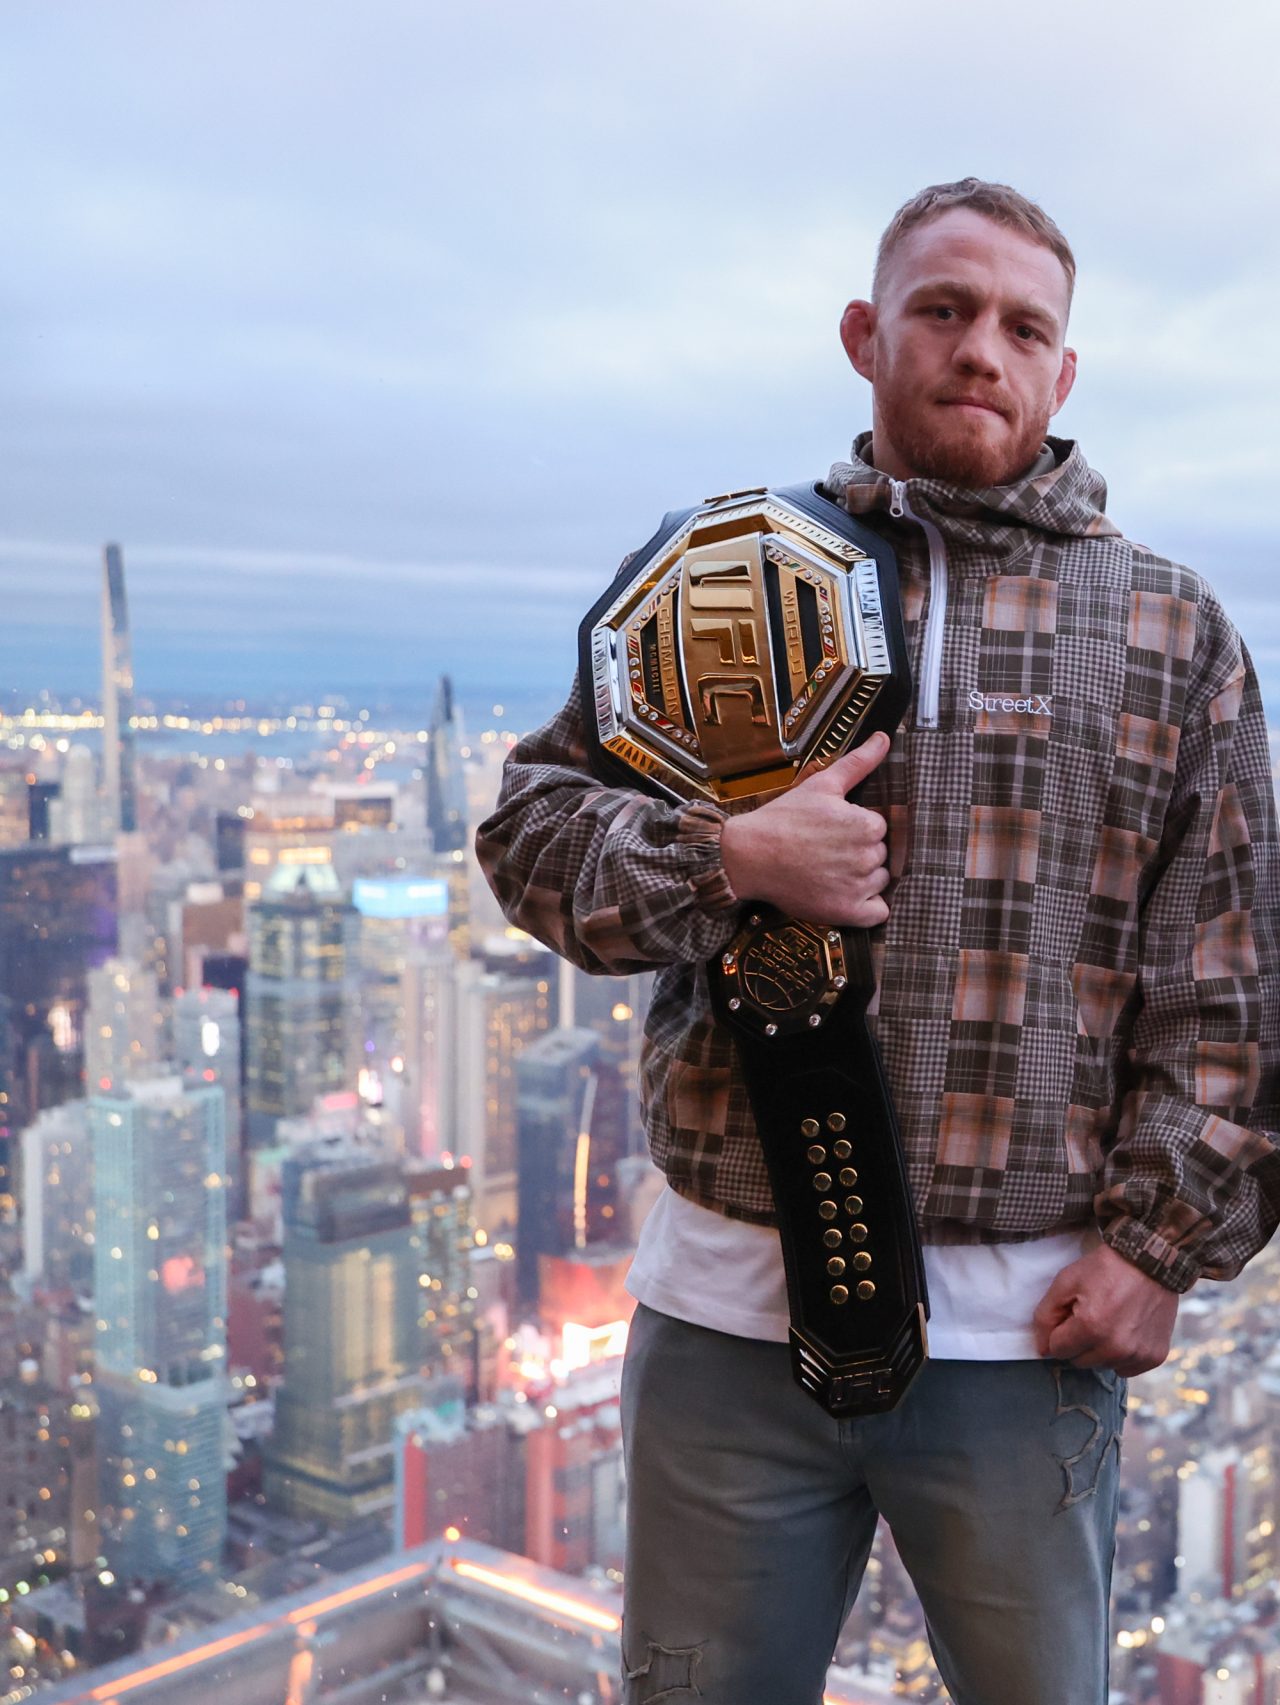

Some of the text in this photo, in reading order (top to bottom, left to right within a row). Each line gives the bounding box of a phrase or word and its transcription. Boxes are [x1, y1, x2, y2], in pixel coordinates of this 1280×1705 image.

[659, 607, 680, 716] CHAMPION
[689, 560, 772, 727] UFC
[783, 590, 803, 675] WORLD
[969, 691, 1054, 716] StreetX
